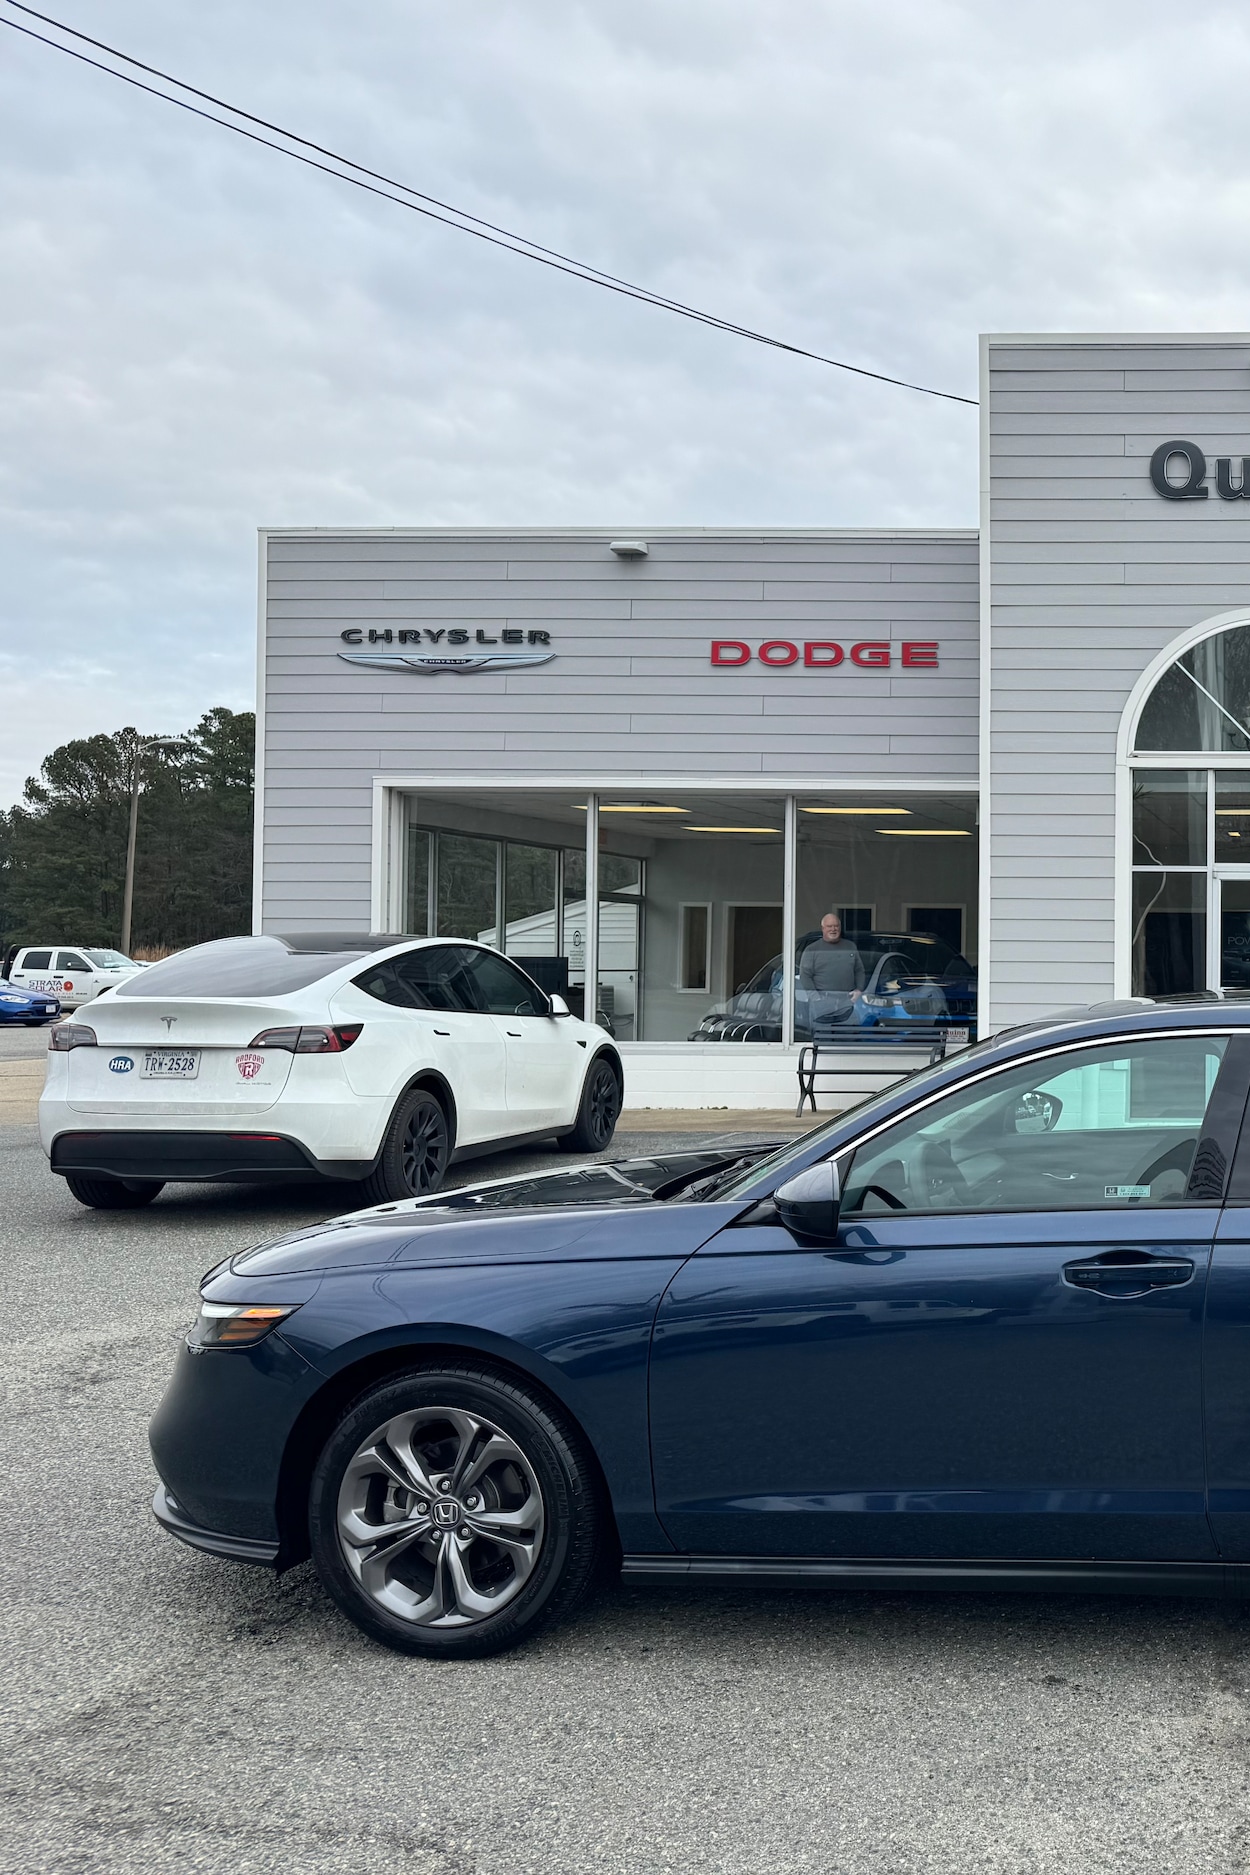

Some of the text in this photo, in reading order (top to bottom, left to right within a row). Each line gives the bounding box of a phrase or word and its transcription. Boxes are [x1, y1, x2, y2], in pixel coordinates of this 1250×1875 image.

[340, 628, 552, 645] CHRYSLER
[710, 640, 940, 668] DODGE
[110, 1060, 131, 1071] HRA
[145, 1057, 195, 1071] TRW-2528
[235, 1053, 265, 1065] RADFORD
